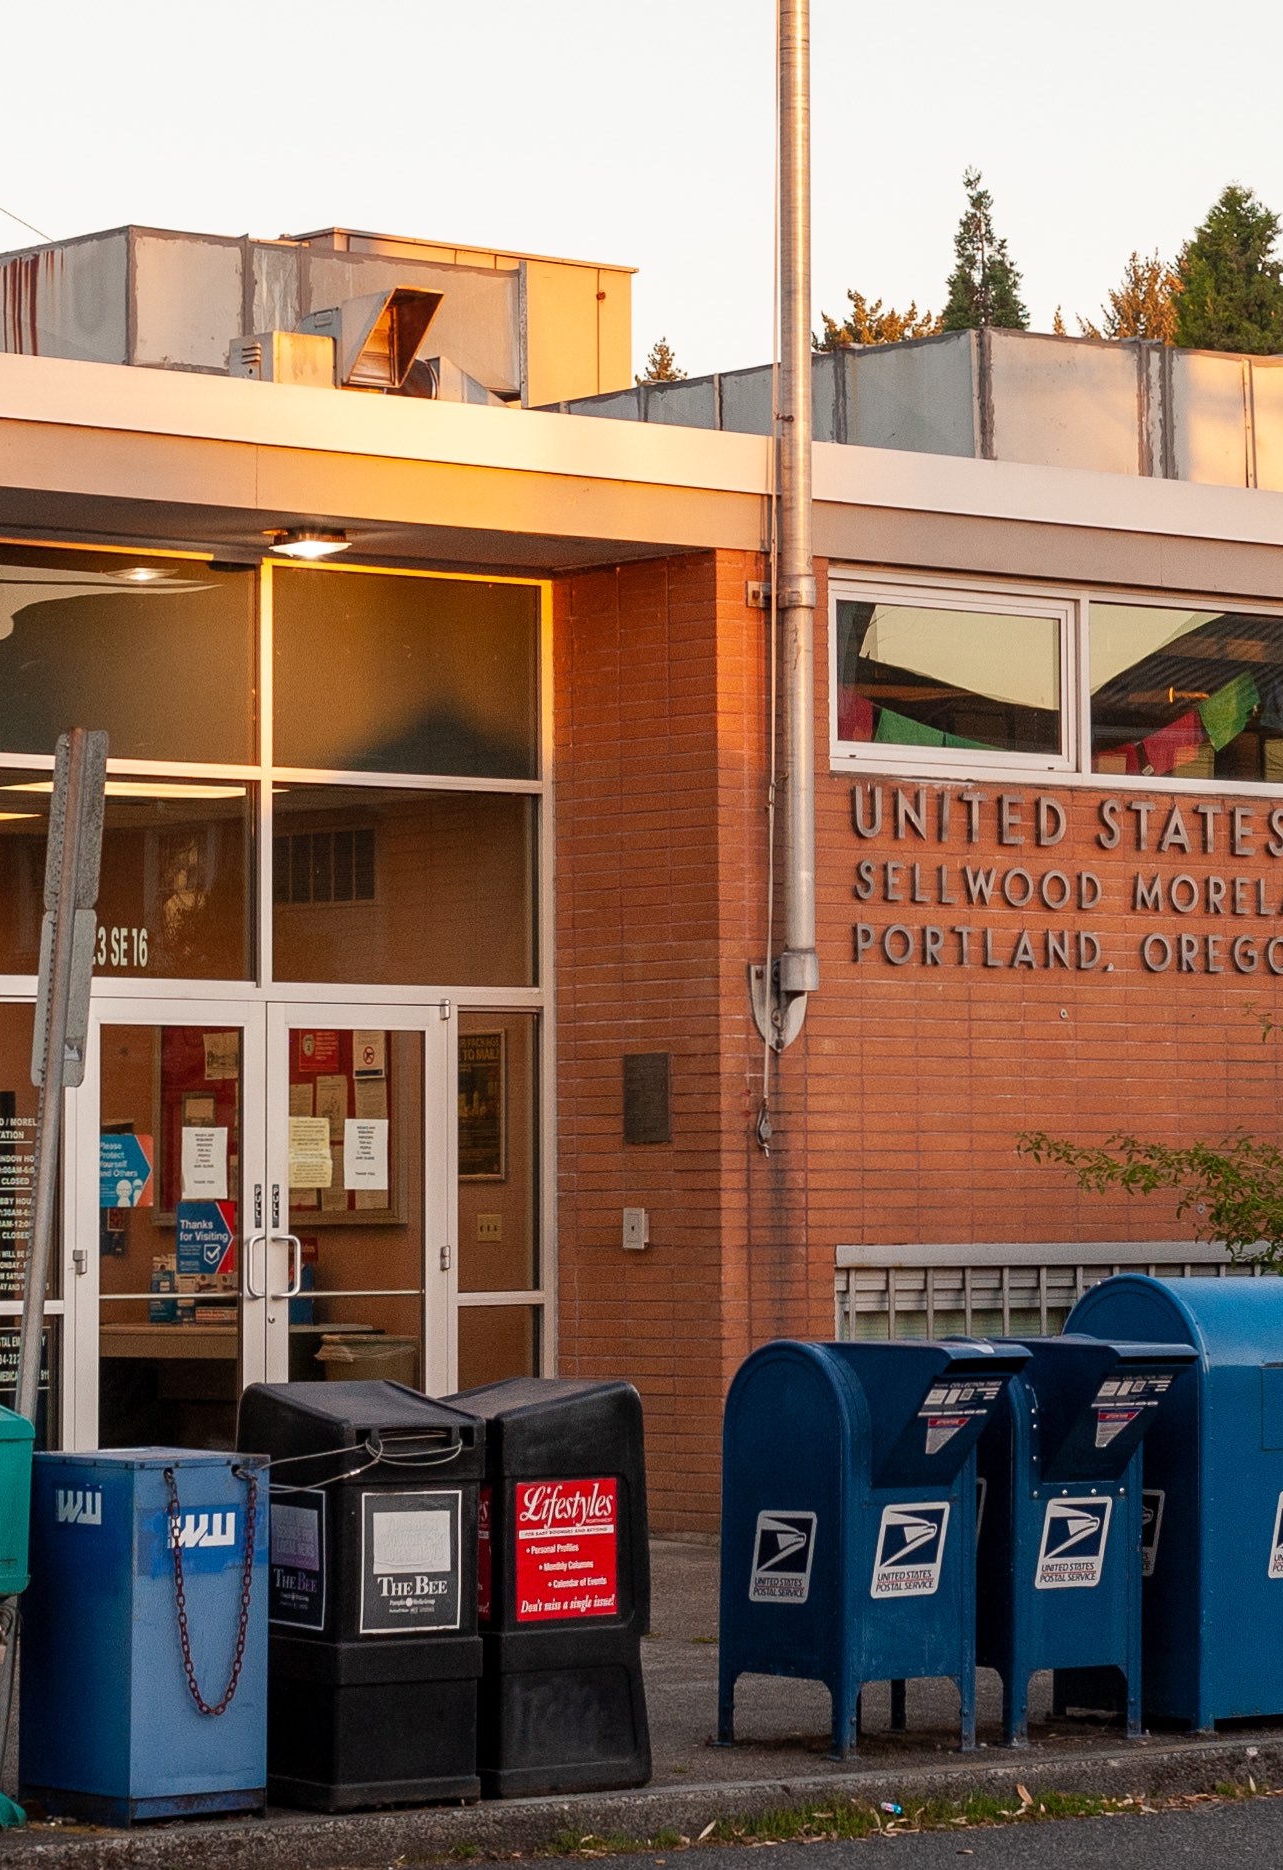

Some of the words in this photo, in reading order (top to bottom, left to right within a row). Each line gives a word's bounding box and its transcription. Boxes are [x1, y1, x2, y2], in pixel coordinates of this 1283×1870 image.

[852, 785, 1067, 846] UNITED
[855, 859, 1103, 910] SELLWOOD
[93, 926, 107, 966] 3
[110, 926, 128, 966] SE
[131, 927, 148, 967] 16
[10, 1117, 37, 1126] MOREL
[113, 1169, 138, 1177] Others
[1, 1177, 30, 1185] CLOSED
[15, 1197, 32, 1205] HOU
[179, 1219, 214, 1230] Thanks
[1, 1231, 30, 1239] CLOSED
[179, 1232, 193, 1242] for
[195, 1232, 229, 1243] Visiting
[6, 1272, 25, 1280] SATUR
[8, 1283, 20, 1291] AND
[519, 1482, 613, 1529] Lifestyles
[531, 1544, 556, 1555] Personal
[557, 1543, 579, 1553] Profiles
[543, 1561, 567, 1572] Monthly
[568, 1560, 594, 1570] Columns
[1041, 1563, 1069, 1572] UNITED
[1069, 1562, 1095, 1570] STATES
[273, 1568, 296, 1589] THE
[297, 1571, 317, 1593] BEE
[877, 1571, 905, 1581] UNITED
[906, 1569, 932, 1579] STATES
[1040, 1574, 1066, 1583] POSTAL
[1067, 1573, 1096, 1582] SERVICE
[377, 1576, 413, 1597] THE
[414, 1575, 448, 1595] BEE
[553, 1578, 579, 1588] Calendar
[579, 1577, 586, 1587] of
[587, 1576, 608, 1586] Events
[754, 1577, 779, 1586] UNITED
[780, 1578, 803, 1587] STATES
[876, 1582, 903, 1592] POSTAL
[904, 1581, 934, 1590] SERVICE
[752, 1587, 777, 1597] POSTAL
[778, 1588, 805, 1598] SERVICE
[521, 1598, 543, 1613] Don't
[544, 1597, 562, 1611] miss
[562, 1600, 569, 1610] a
[570, 1594, 592, 1613] single
